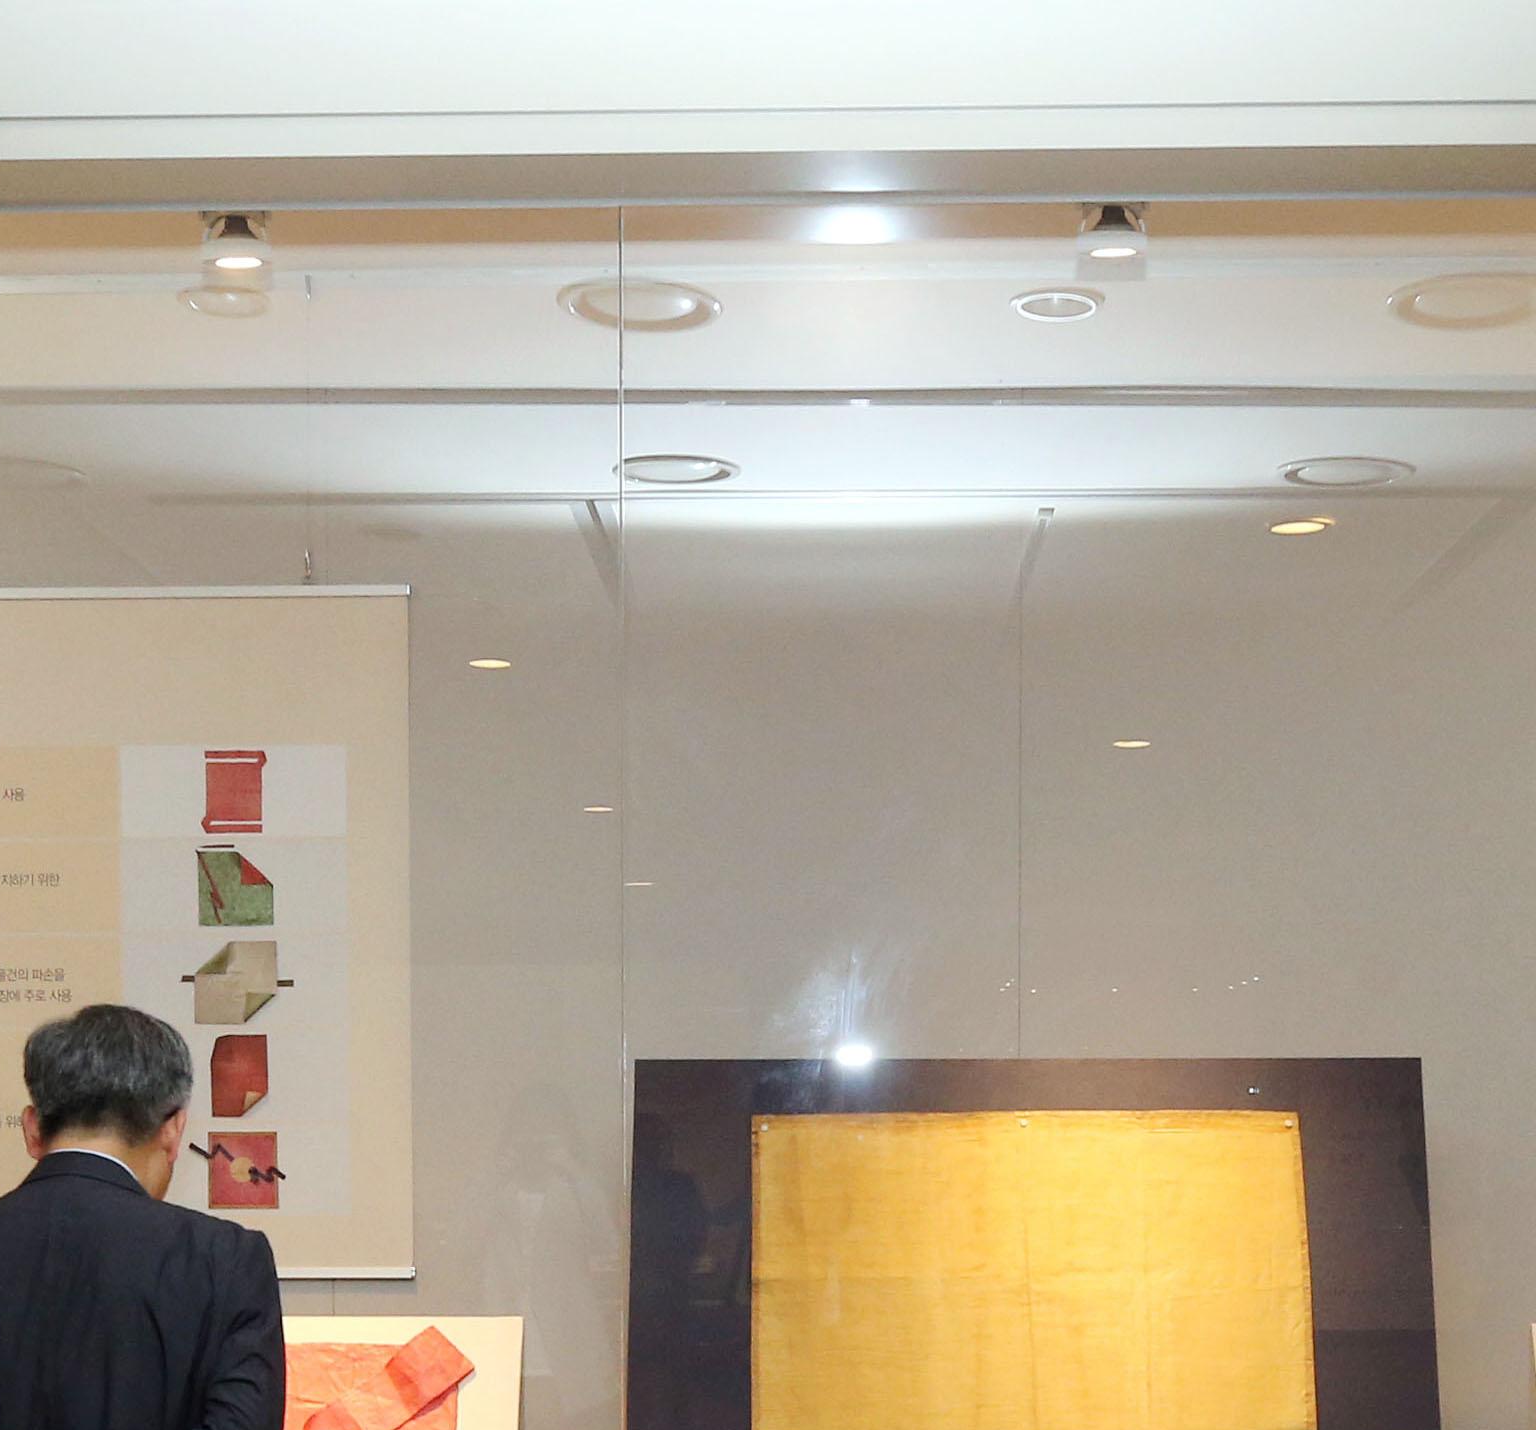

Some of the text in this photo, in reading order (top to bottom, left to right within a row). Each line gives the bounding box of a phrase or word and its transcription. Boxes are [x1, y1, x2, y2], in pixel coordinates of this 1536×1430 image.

[3, 788, 24, 801] 사용
[38, 873, 59, 887] 위한
[25, 990, 46, 1001] 주로
[50, 989, 72, 1002] 사용
